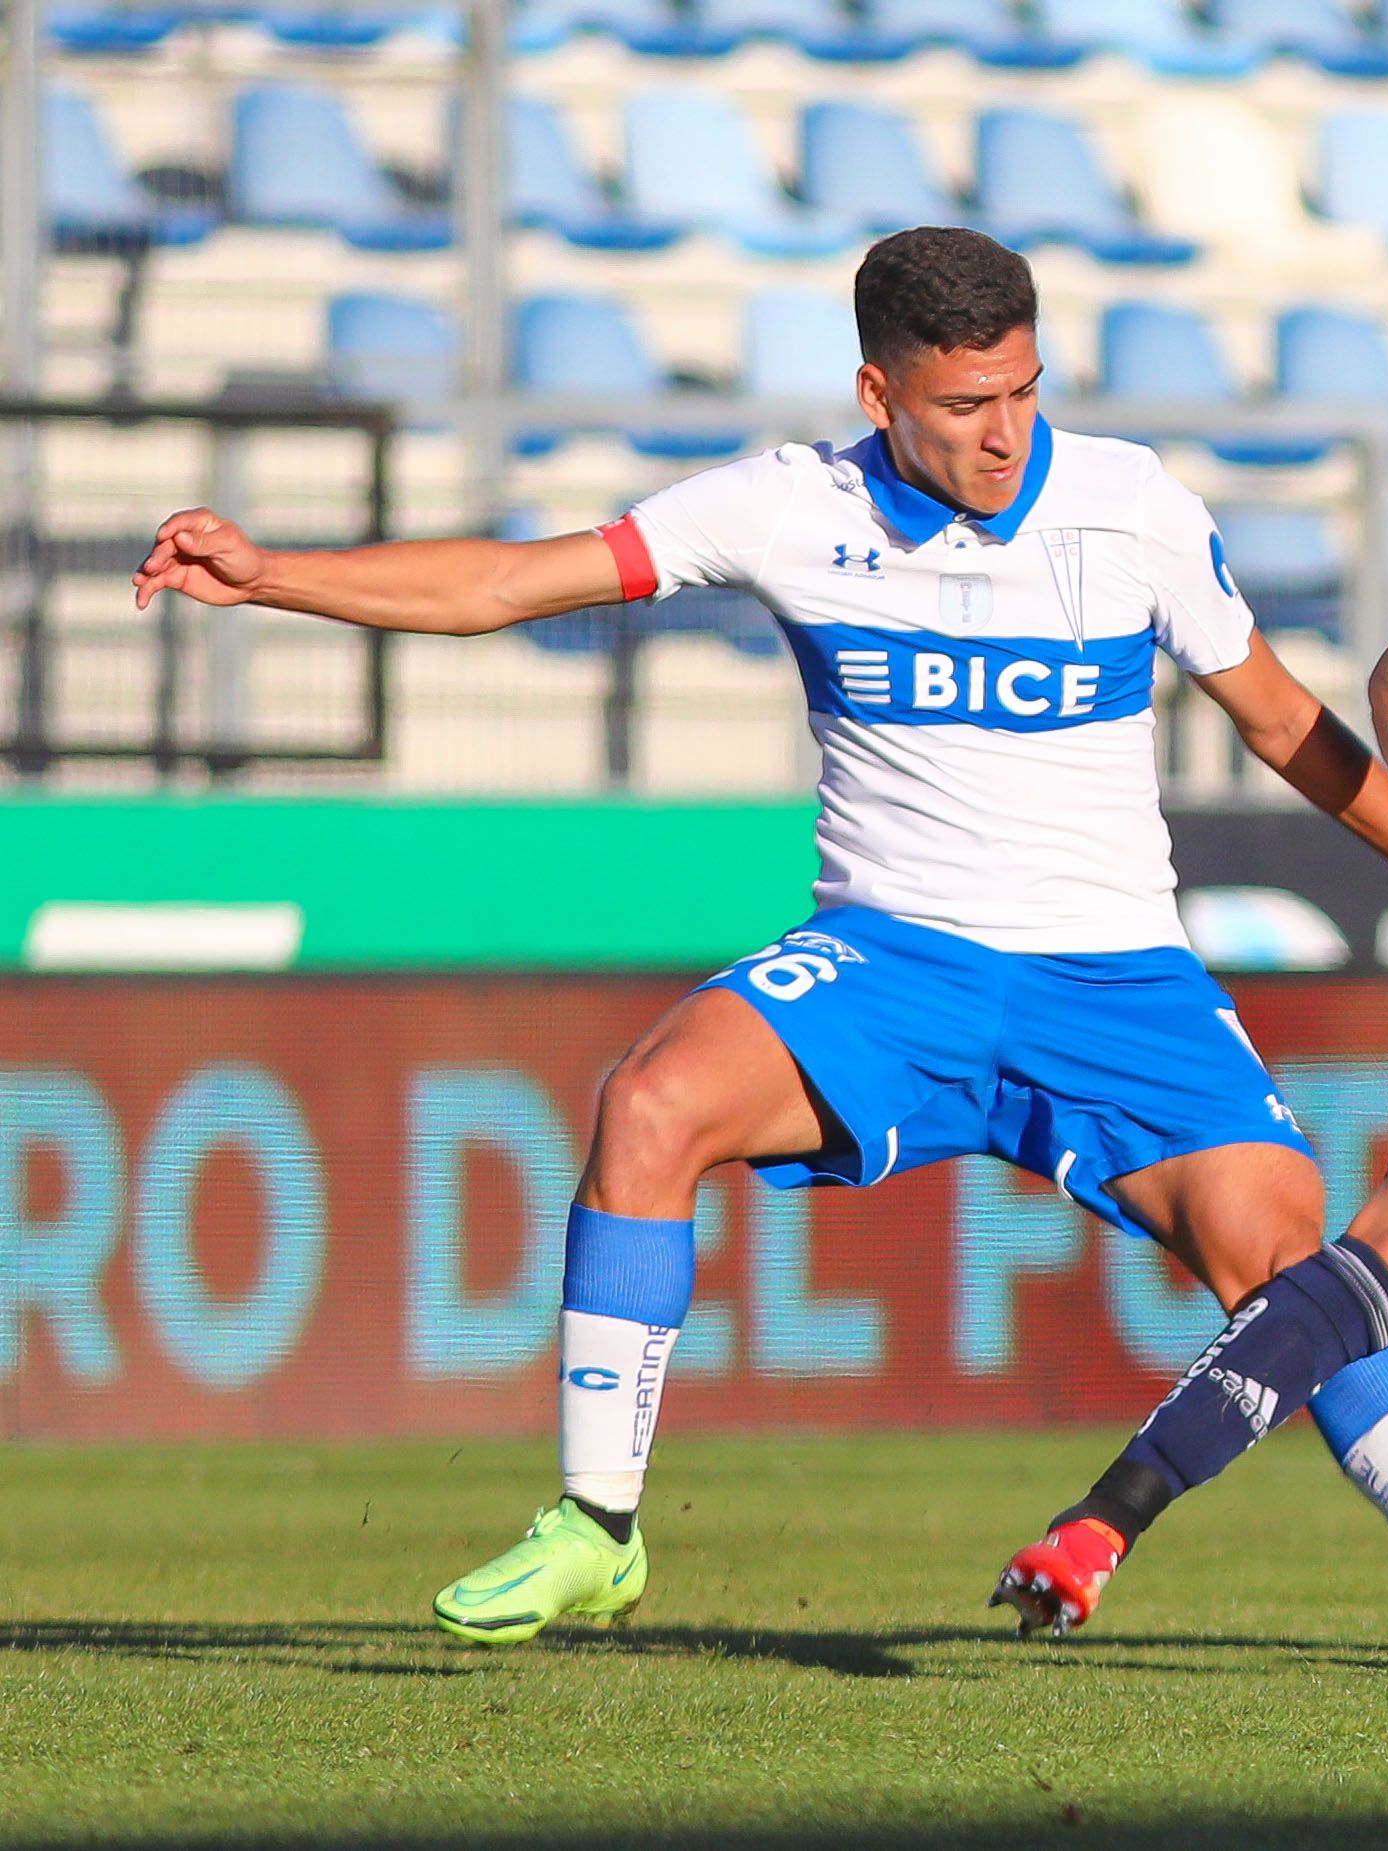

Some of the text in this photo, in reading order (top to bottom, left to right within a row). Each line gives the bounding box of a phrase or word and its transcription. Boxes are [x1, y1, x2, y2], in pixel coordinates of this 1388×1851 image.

[912, 652, 1100, 717] BICE
[0, 1060, 330, 1390] RO
[1137, 1297, 1270, 1436] olorub
